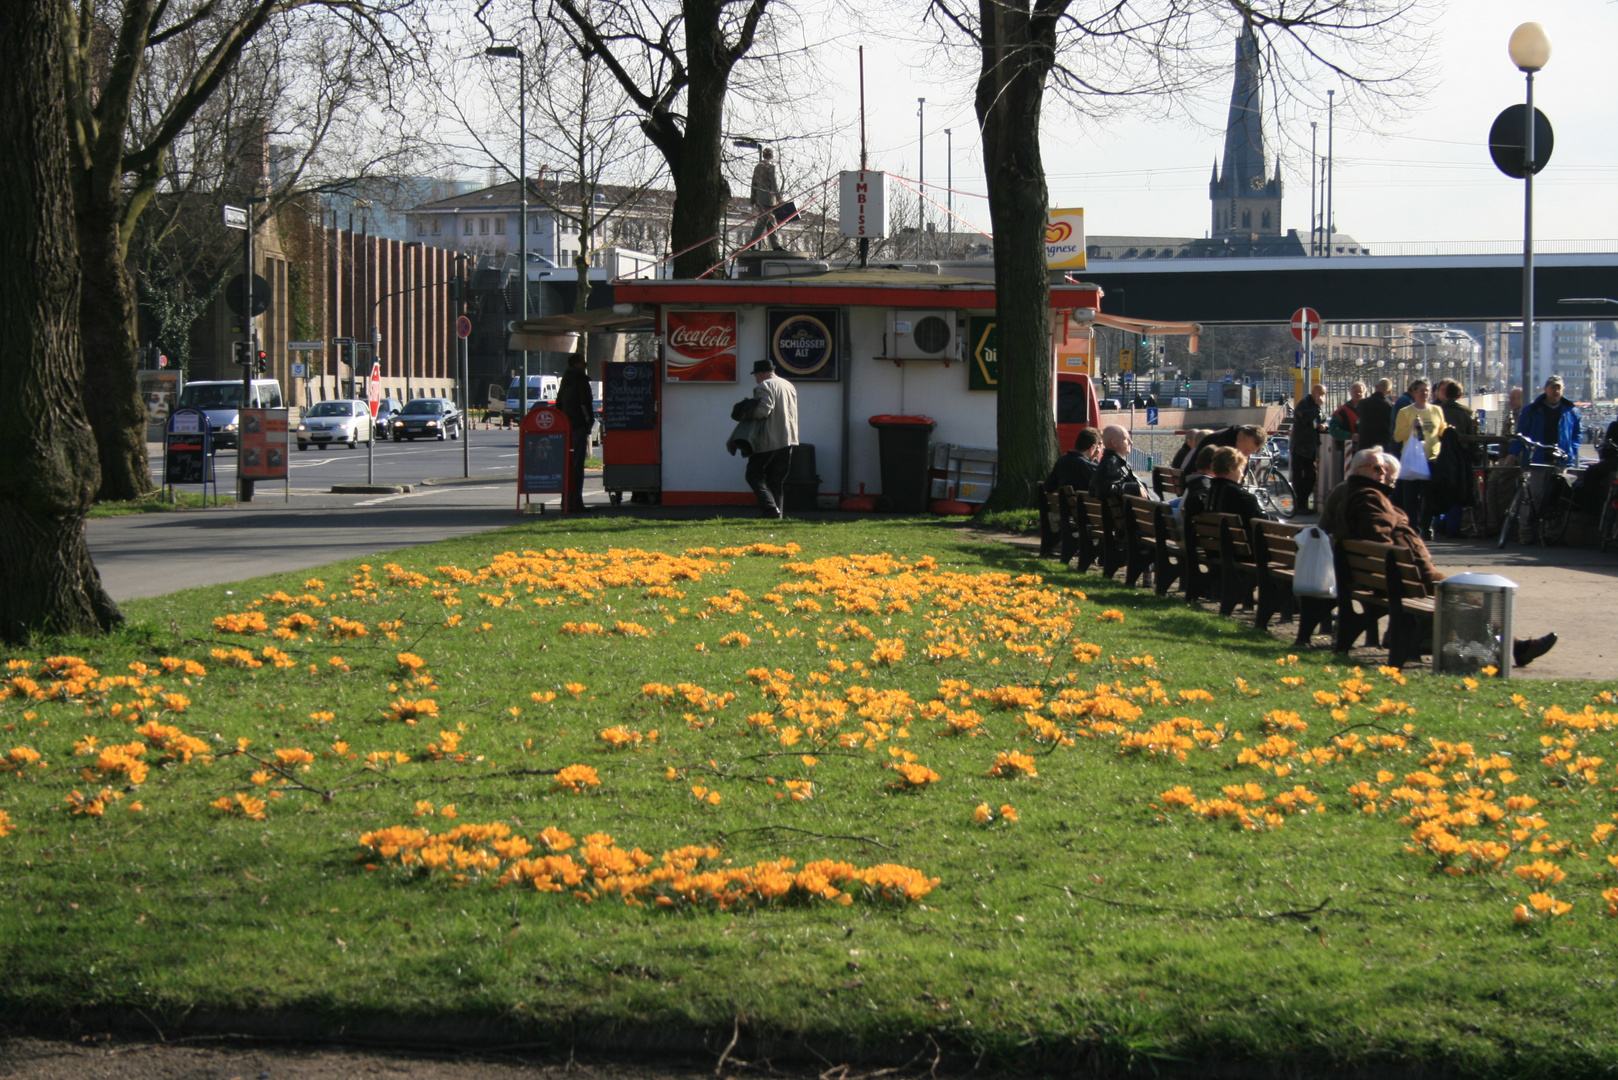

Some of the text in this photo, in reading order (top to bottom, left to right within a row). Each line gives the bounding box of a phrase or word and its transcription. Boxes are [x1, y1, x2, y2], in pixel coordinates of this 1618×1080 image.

[856, 173, 867, 235] IMBISS
[779, 337, 826, 349] SCHLÖSSER
[795, 348, 810, 358] ALT
